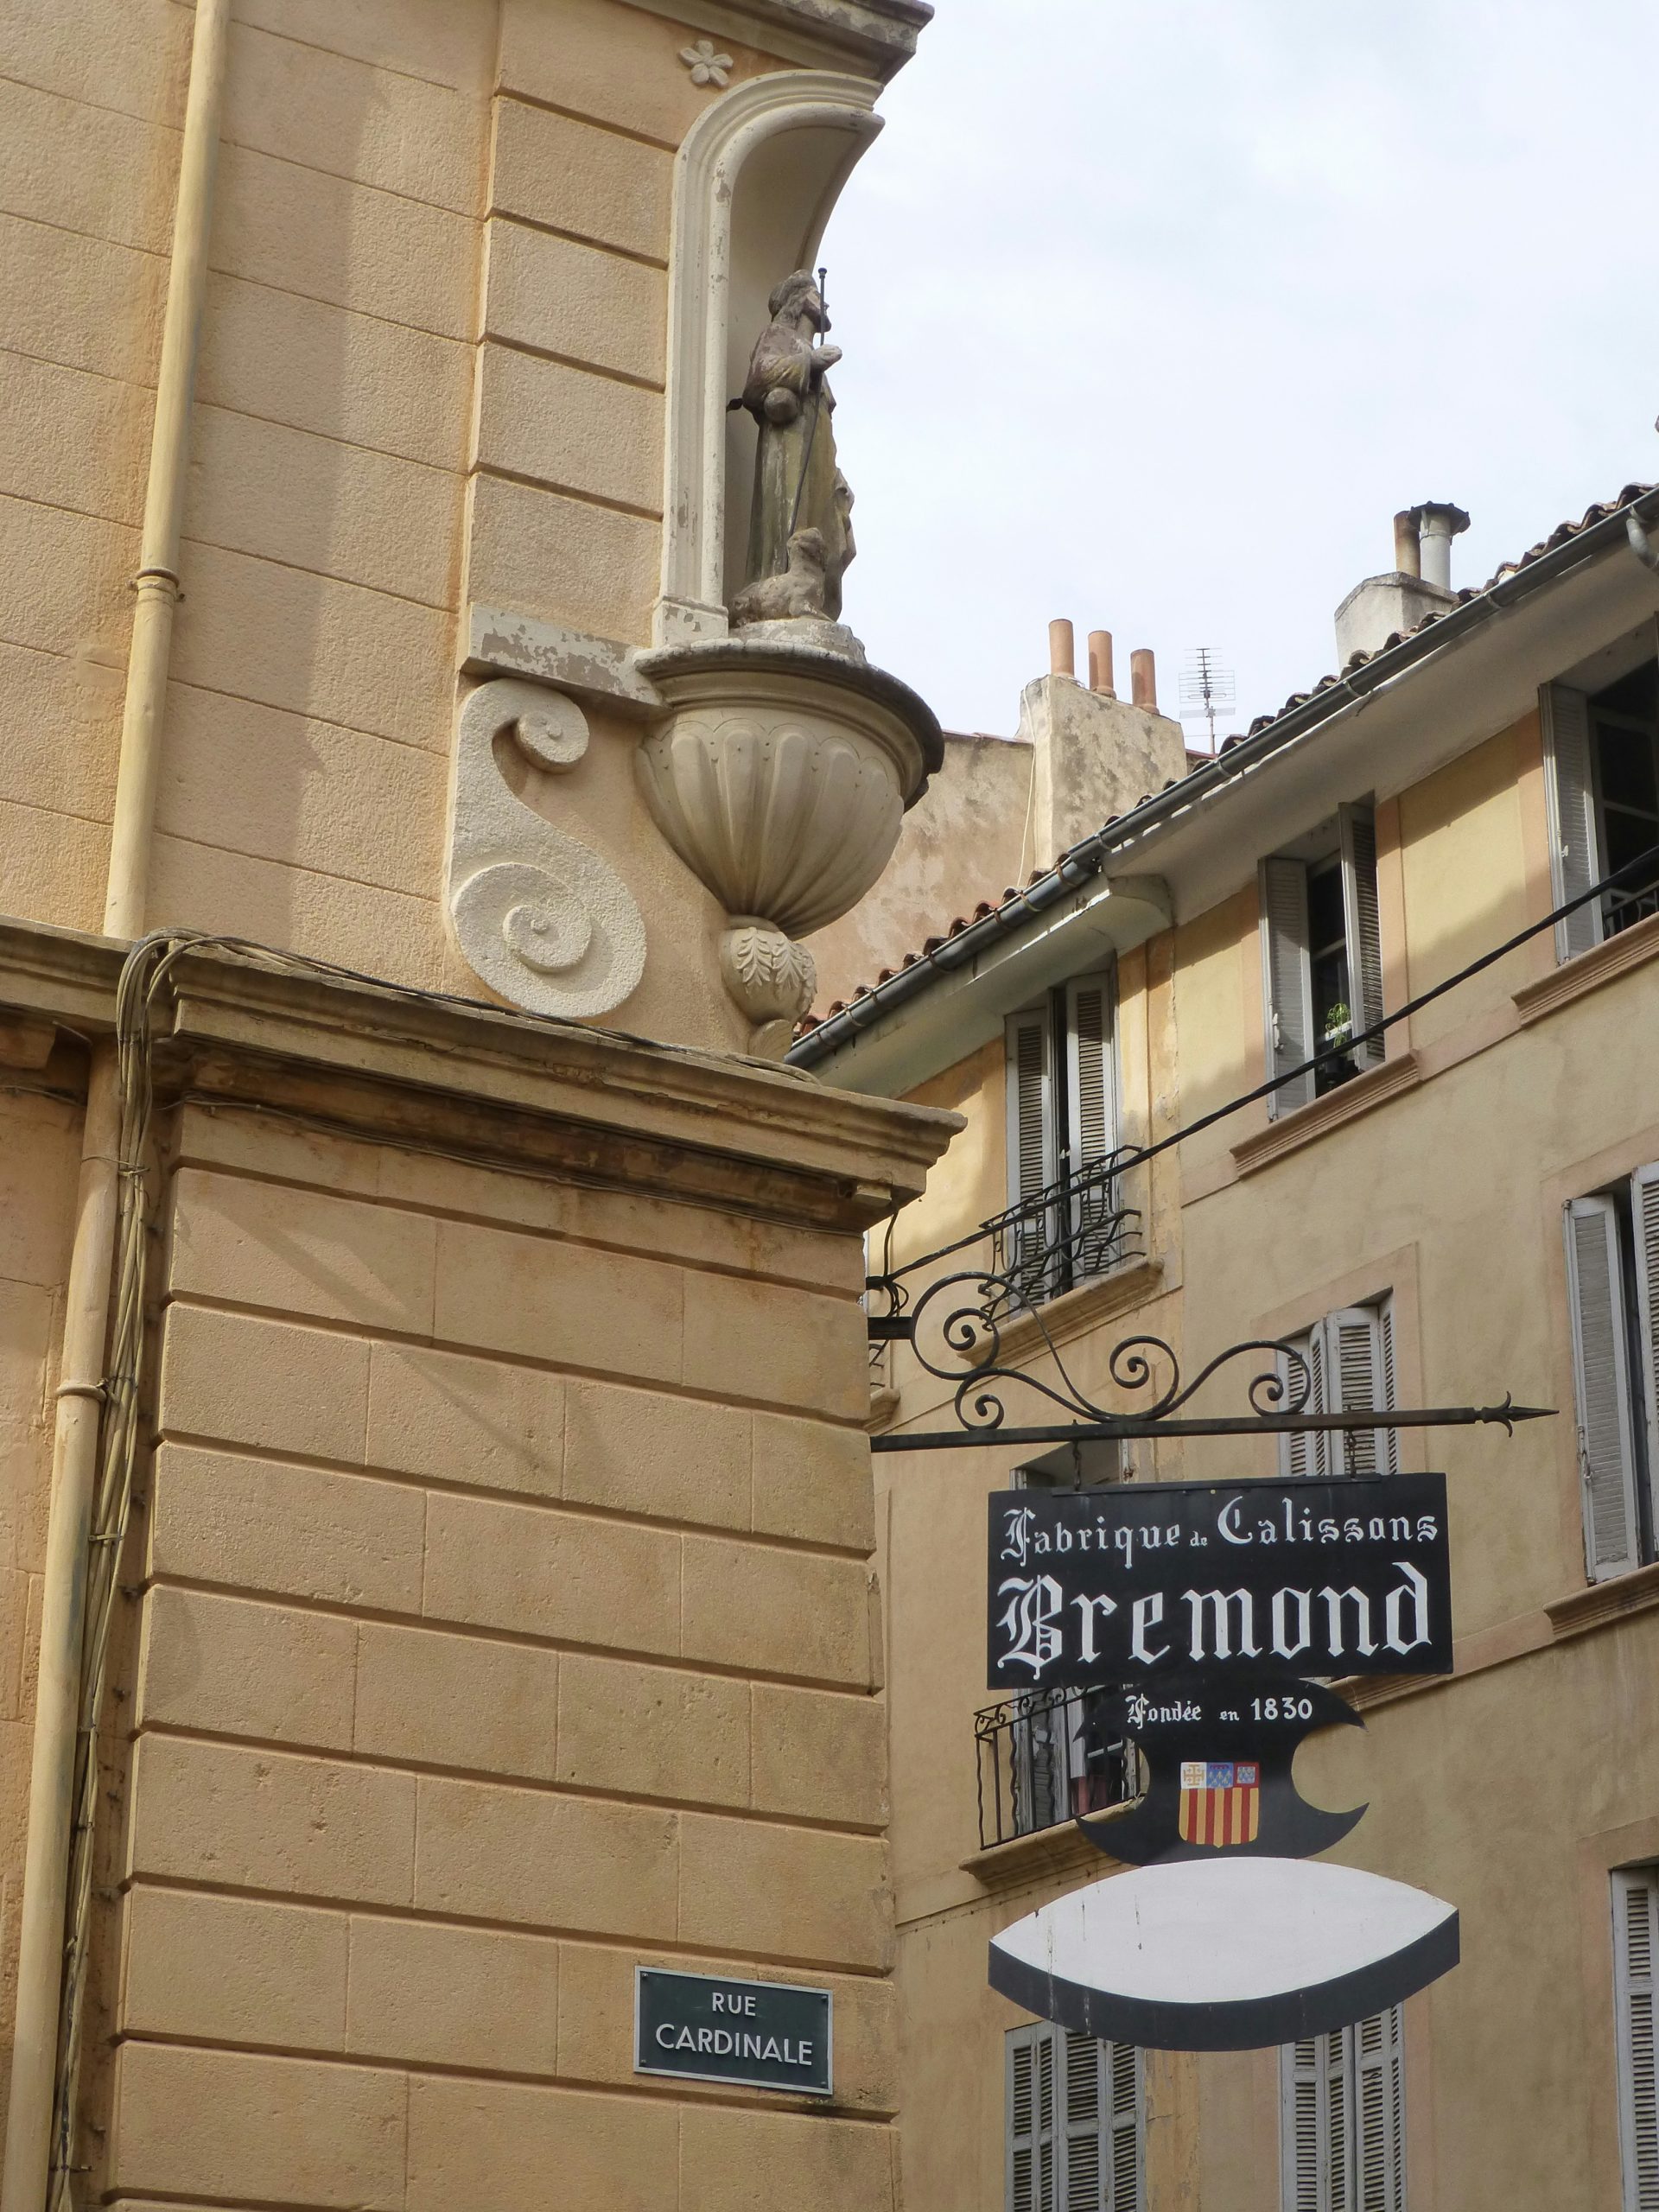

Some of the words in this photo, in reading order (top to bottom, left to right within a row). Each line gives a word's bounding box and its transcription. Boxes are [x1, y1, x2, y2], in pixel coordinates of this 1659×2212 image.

[1001, 1507, 1181, 1569] Fabrique
[1190, 1529, 1208, 1548] de
[1217, 1496, 1438, 1545] Calissons
[996, 1561, 1433, 1680] Bremond
[1126, 1694, 1202, 1730] Fondée
[1219, 1708, 1240, 1722] en
[1250, 1696, 1313, 1721] 1830
[712, 1992, 757, 2017] RUE
[656, 2023, 813, 2066] CARDINALE
